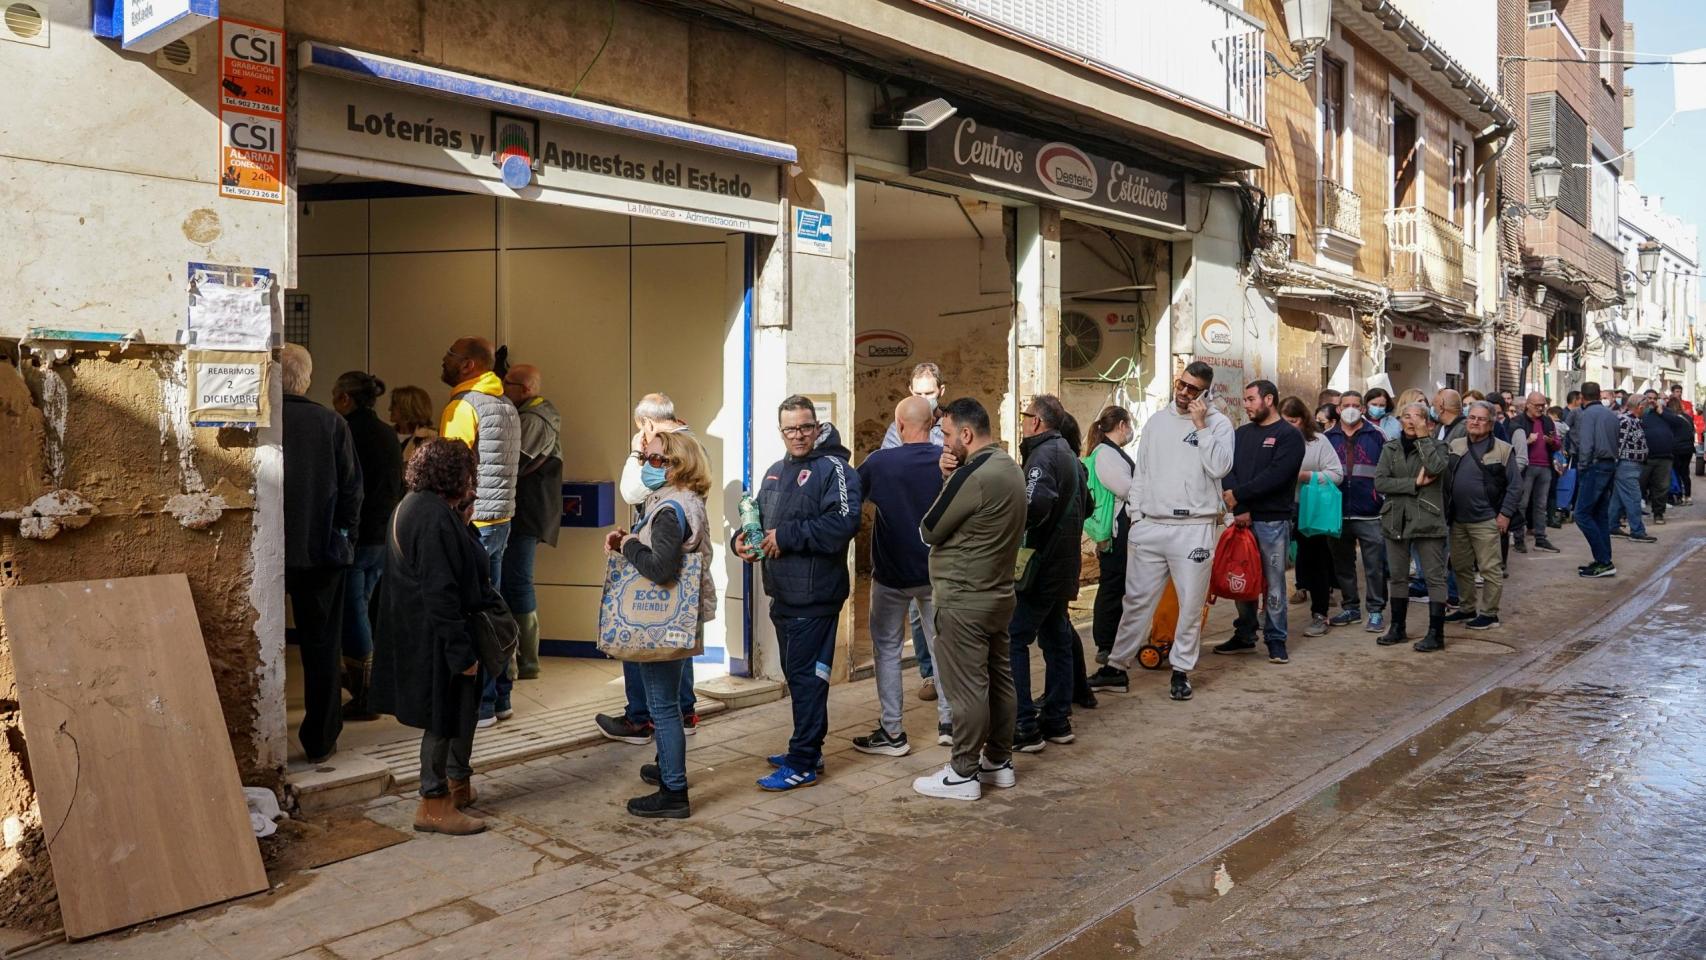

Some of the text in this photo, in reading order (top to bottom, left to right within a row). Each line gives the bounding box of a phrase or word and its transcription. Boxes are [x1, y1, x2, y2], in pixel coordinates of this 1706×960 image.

[230, 33, 275, 65] CSI
[232, 68, 242, 76] DE
[255, 85, 274, 97] 24h
[238, 100, 251, 108] 902
[230, 122, 275, 152] CSI
[347, 105, 485, 160] Loterías y
[953, 116, 1024, 174] Centros
[230, 148, 275, 164] ALARMA
[543, 141, 752, 199] Apuestas del Estado
[251, 171, 272, 183] 24h
[1055, 166, 1093, 188] Destetic
[237, 188, 250, 196] 902
[1107, 160, 1169, 212] Estéticos
[627, 203, 637, 212] La
[1120, 314, 1135, 323] LG
[207, 367, 255, 376] REABRIMOS
[227, 380, 233, 389] 2
[203, 393, 258, 404] DICIEMBRE
[634, 589, 671, 601] ECO
[632, 601, 669, 612] FRIENDLY
